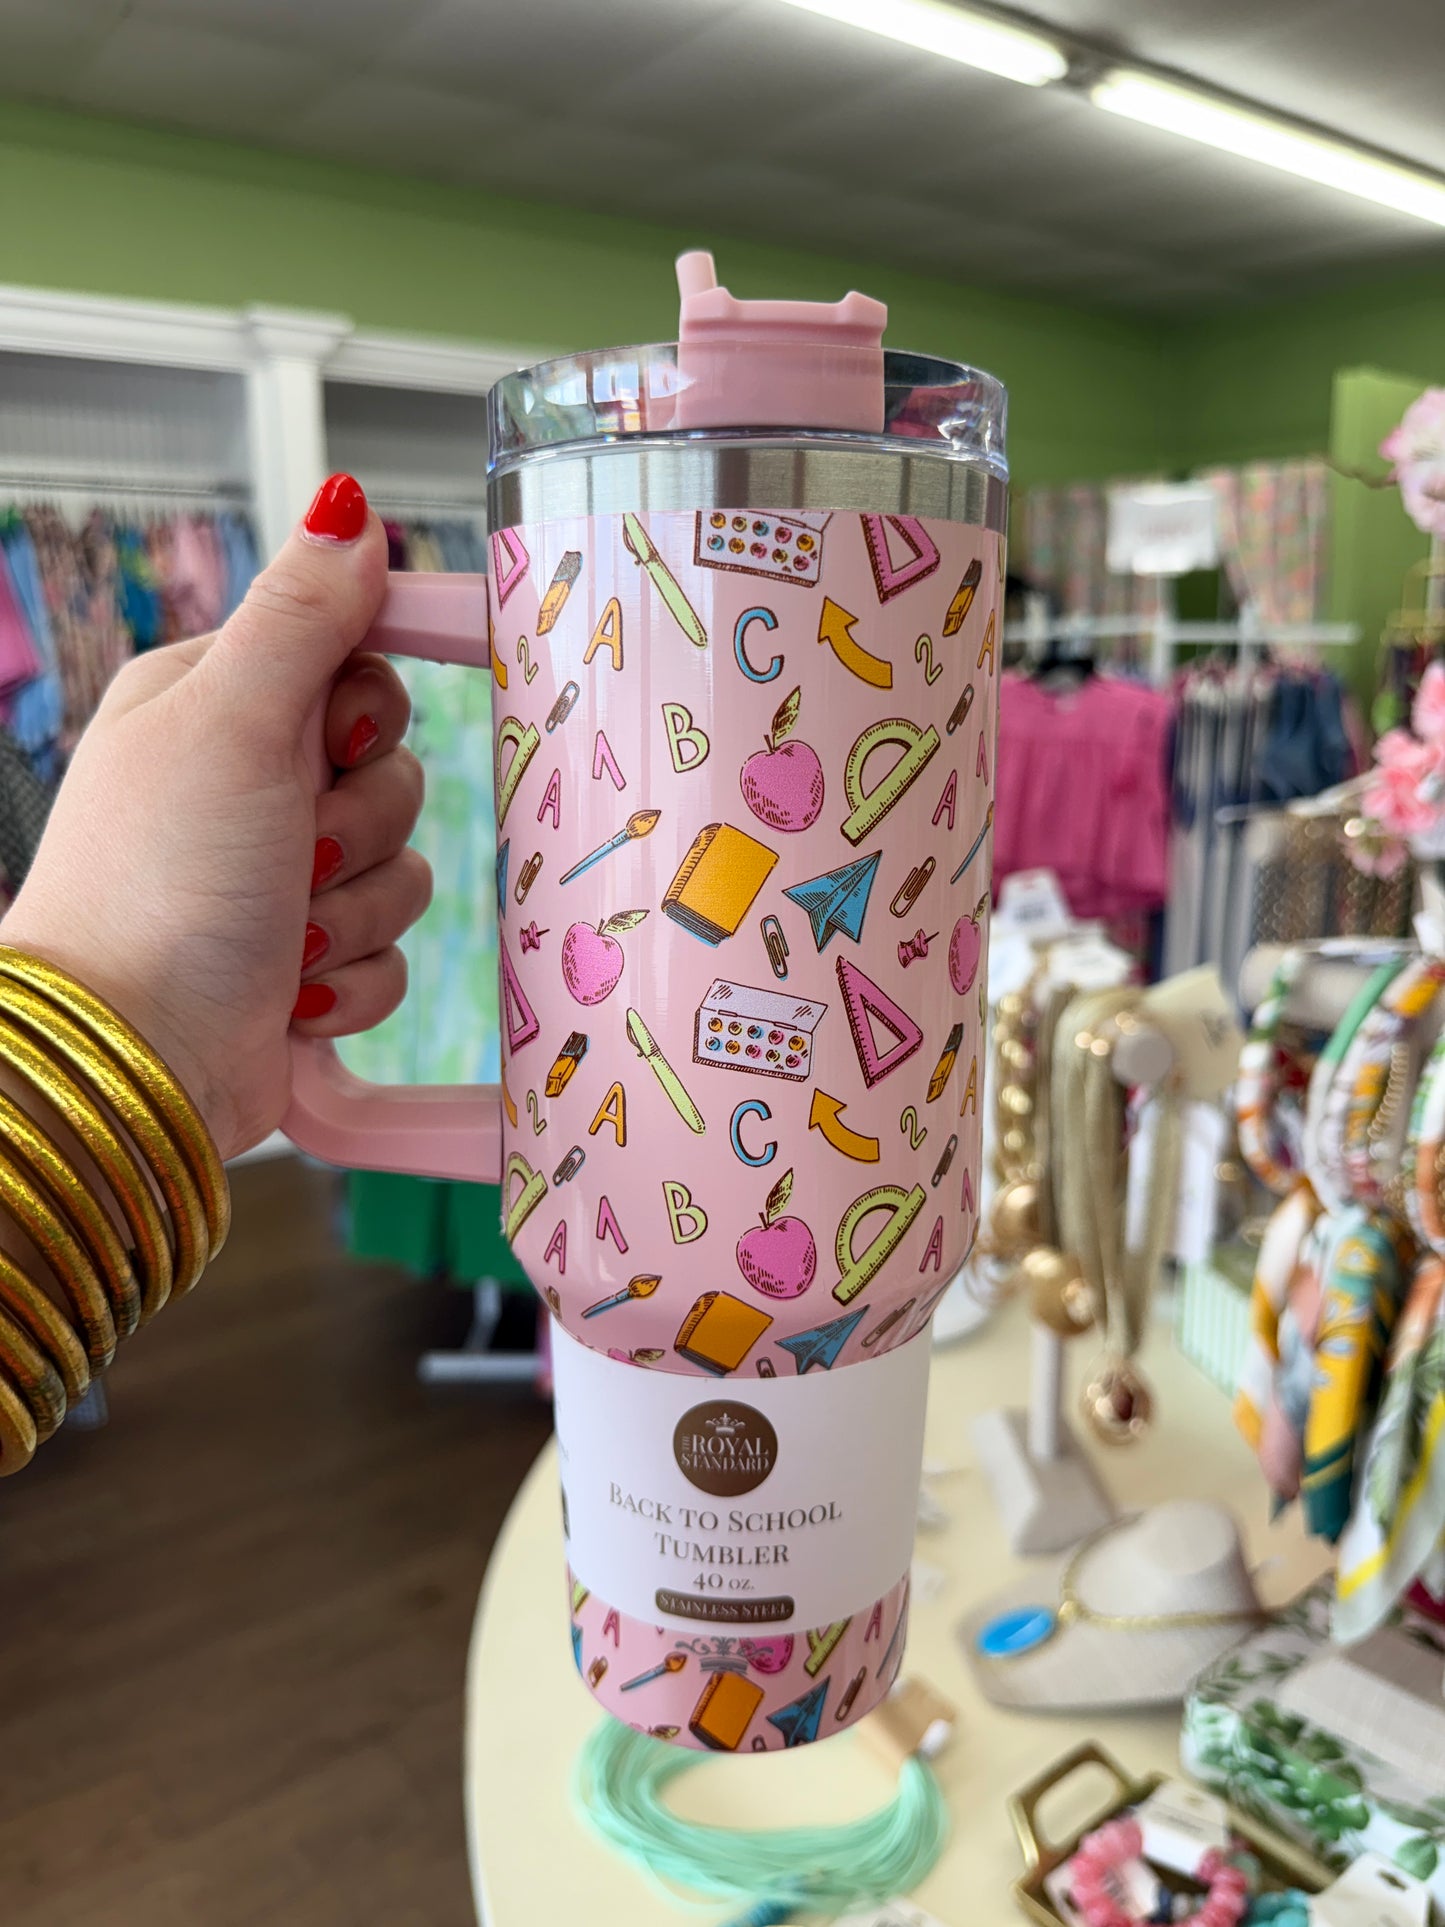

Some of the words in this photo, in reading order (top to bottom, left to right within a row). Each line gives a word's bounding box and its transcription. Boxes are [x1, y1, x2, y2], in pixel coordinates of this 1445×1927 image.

[517, 635, 539, 685] 2
[583, 597, 624, 672] A
[733, 606, 785, 683] C
[915, 633, 943, 686] 2
[662, 703, 710, 773] B
[537, 767, 562, 829] A
[932, 769, 957, 830] A
[526, 1089, 547, 1136] 2
[588, 1081, 627, 1147] A
[729, 1099, 778, 1168] C
[900, 1105, 928, 1151] 2
[662, 1180, 708, 1244] B
[543, 1219, 567, 1274] A
[919, 1215, 944, 1272] A
[681, 1453, 769, 1473] STANDARD
[692, 1434, 769, 1457] ROYAL
[609, 1482, 672, 1525] BACK
[678, 1508, 719, 1531] TO
[727, 1501, 843, 1533] SCHOOL
[653, 1531, 790, 1566] TUMBLER
[658, 1593, 738, 1617] STAINLESS
[741, 1603, 790, 1617] STEEL
[693, 1571, 724, 1591] 40
